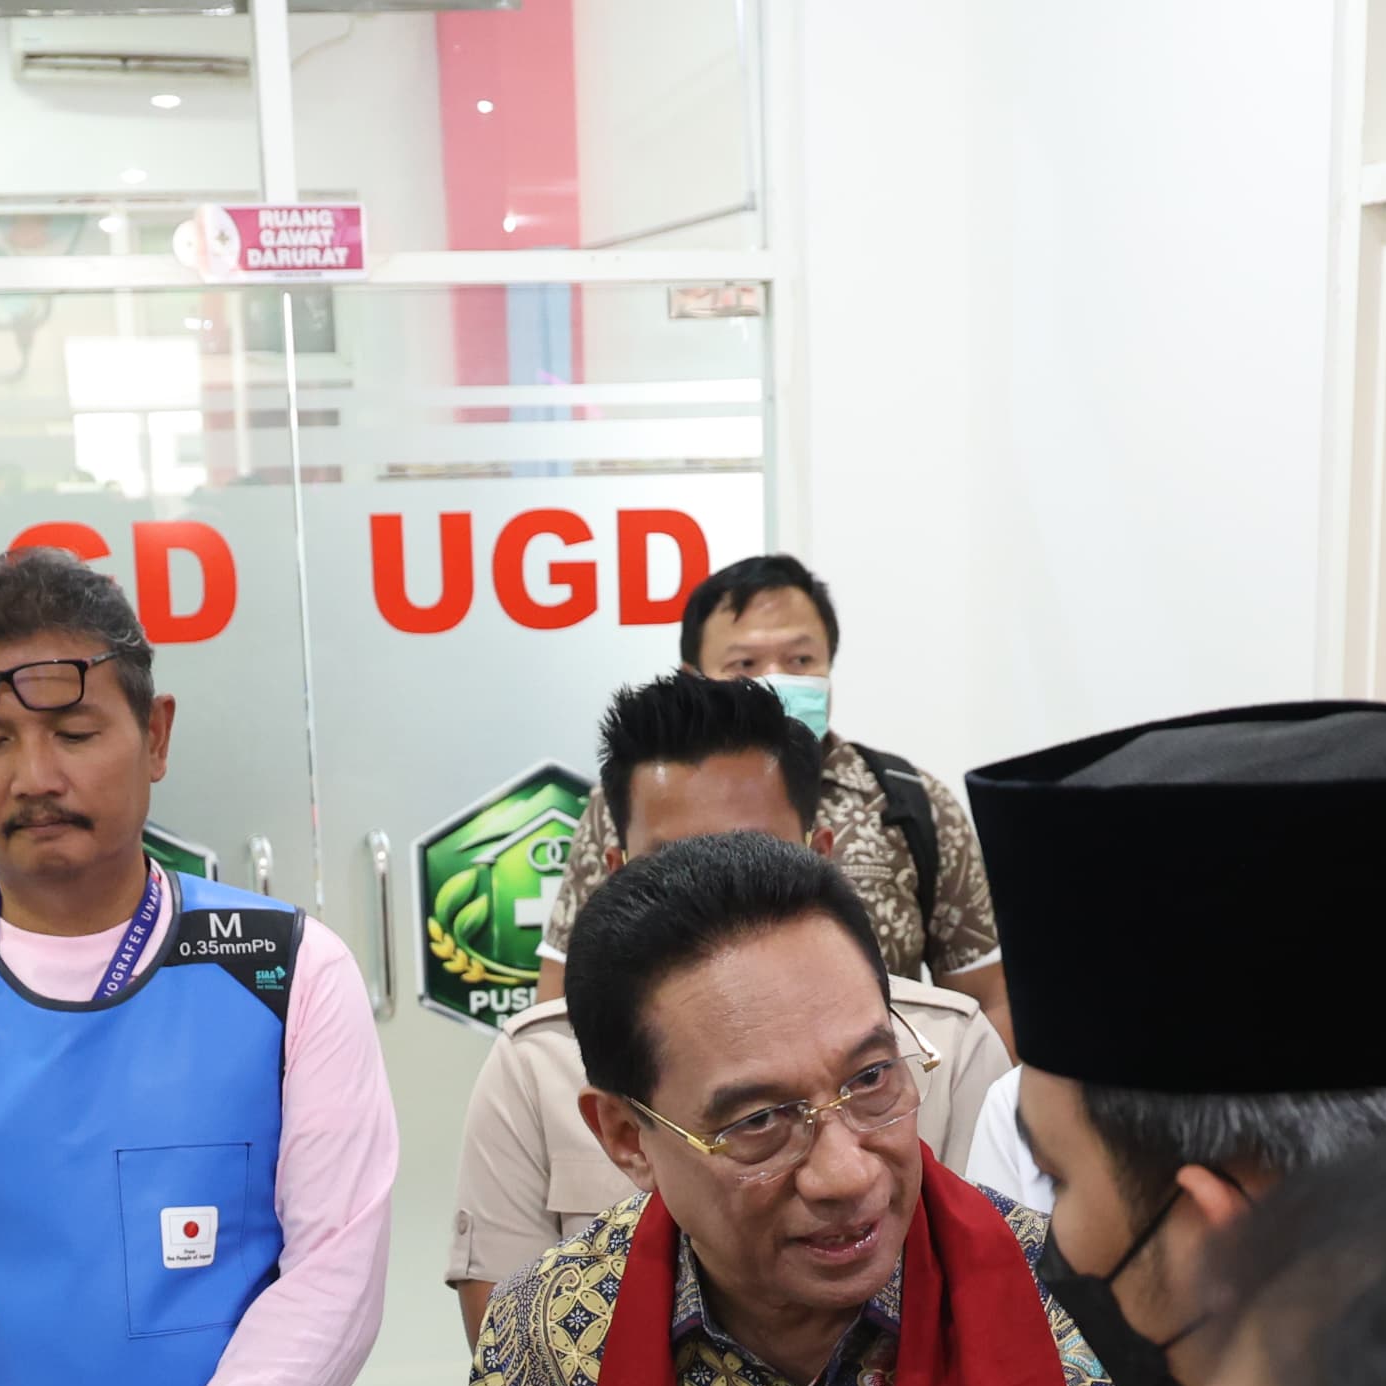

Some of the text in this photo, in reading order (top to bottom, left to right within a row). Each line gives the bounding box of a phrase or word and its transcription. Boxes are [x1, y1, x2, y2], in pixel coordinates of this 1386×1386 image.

[258, 209, 335, 228] RUANG
[259, 228, 334, 246] GAWAT
[246, 247, 350, 267] DARURAT
[370, 507, 710, 634] UGD
[208, 912, 243, 938] M
[179, 939, 276, 956] 0.35mmPb
